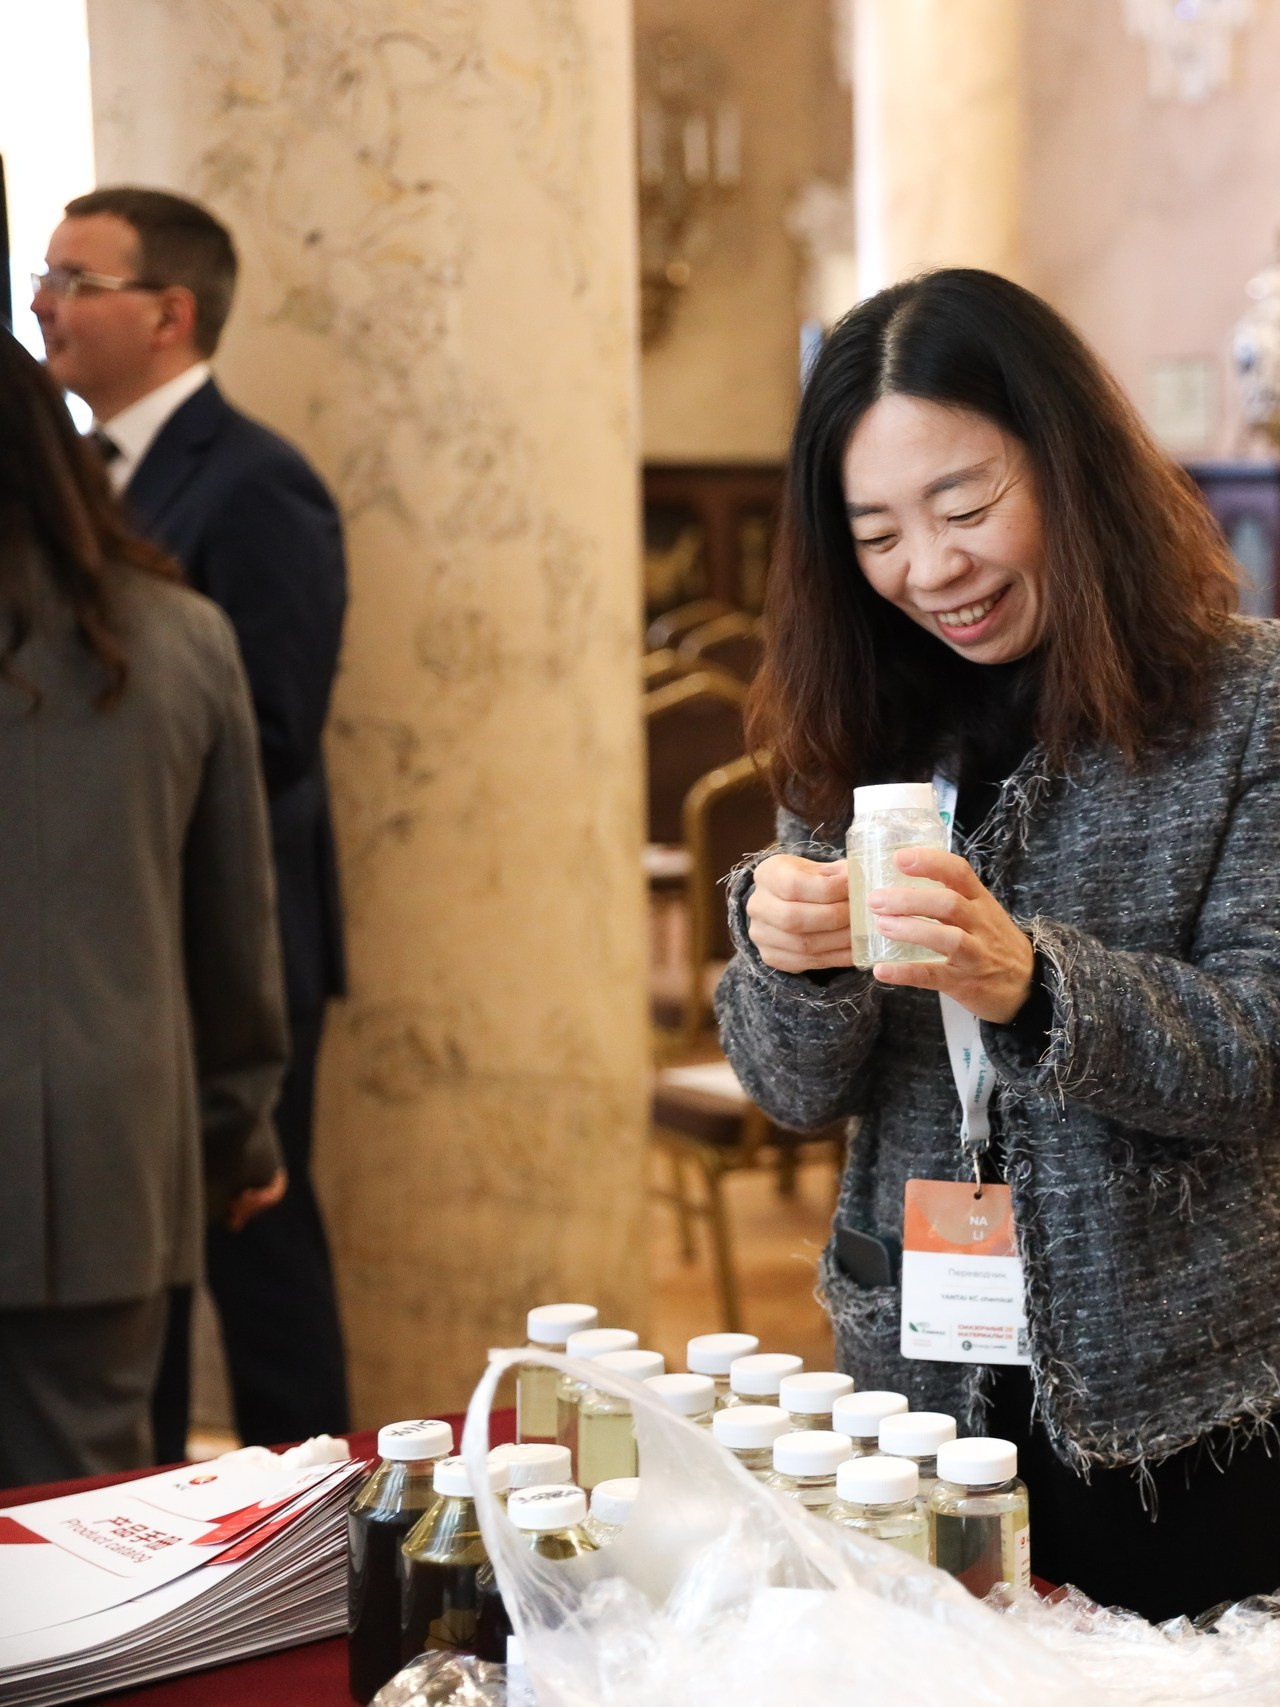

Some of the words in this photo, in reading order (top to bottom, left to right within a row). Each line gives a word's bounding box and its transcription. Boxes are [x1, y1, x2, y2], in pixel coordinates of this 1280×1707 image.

[974, 1069, 987, 1104] Leader
[969, 1216, 988, 1226] NA
[973, 1230, 984, 1241] LI
[59, 1518, 114, 1545] Product
[92, 1516, 184, 1551] 产品手册
